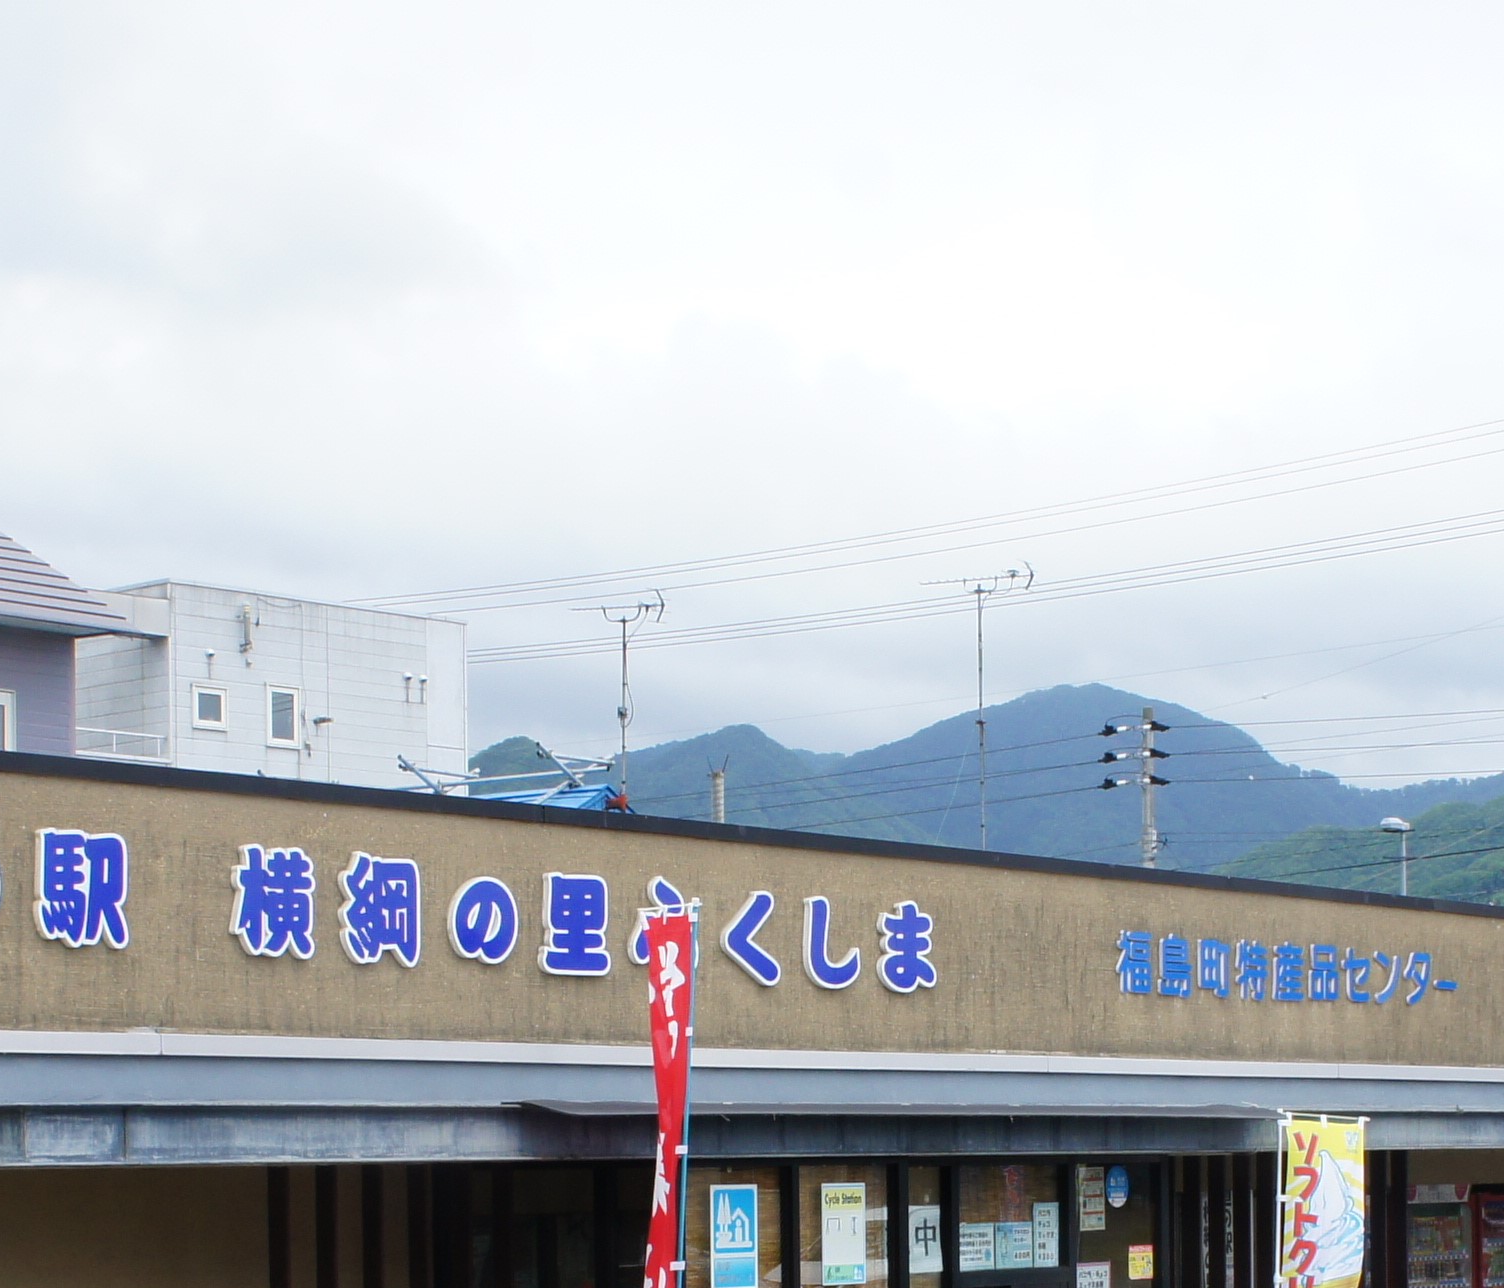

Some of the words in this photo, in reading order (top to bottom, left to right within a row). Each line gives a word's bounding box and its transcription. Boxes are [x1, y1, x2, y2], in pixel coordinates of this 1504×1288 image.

[1116, 929, 1458, 1006] 福島町特産品センター
[915, 1216, 937, 1257] 中
